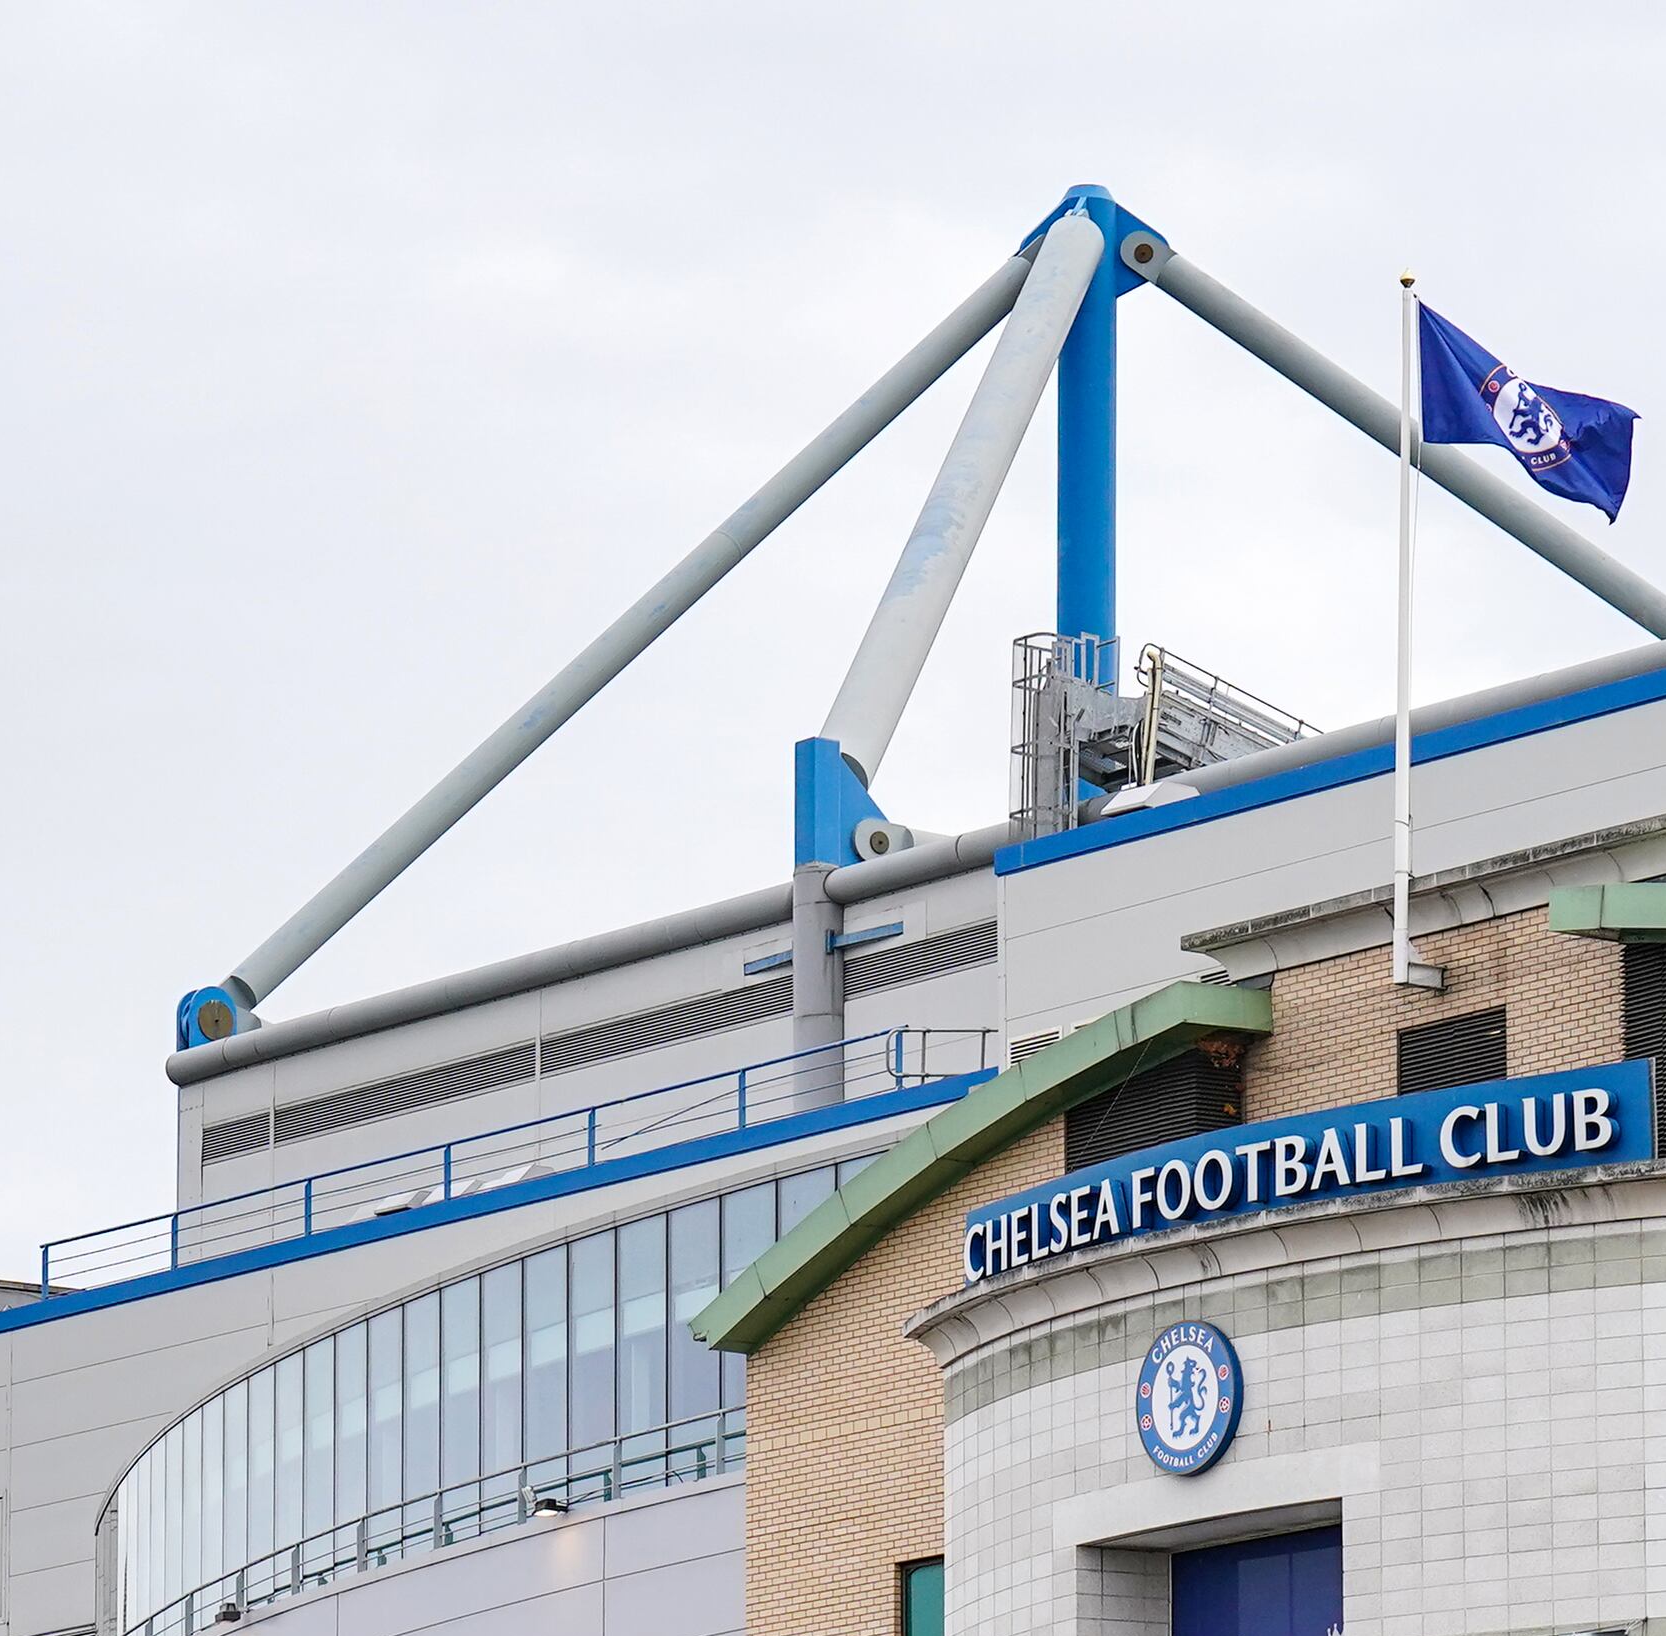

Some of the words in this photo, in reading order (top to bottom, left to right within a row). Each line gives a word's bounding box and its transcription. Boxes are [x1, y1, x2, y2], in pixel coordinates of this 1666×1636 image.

[1530, 452, 1557, 466] CLUB
[964, 1177, 1120, 1283] CHELSEA
[1130, 1116, 1423, 1230] FOOTBALL
[1440, 1088, 1614, 1169] CLUB
[1151, 1326, 1214, 1364] CHELSEA
[1152, 1445, 1194, 1467] FOOTBALL
[1197, 1432, 1218, 1458] CLUB
